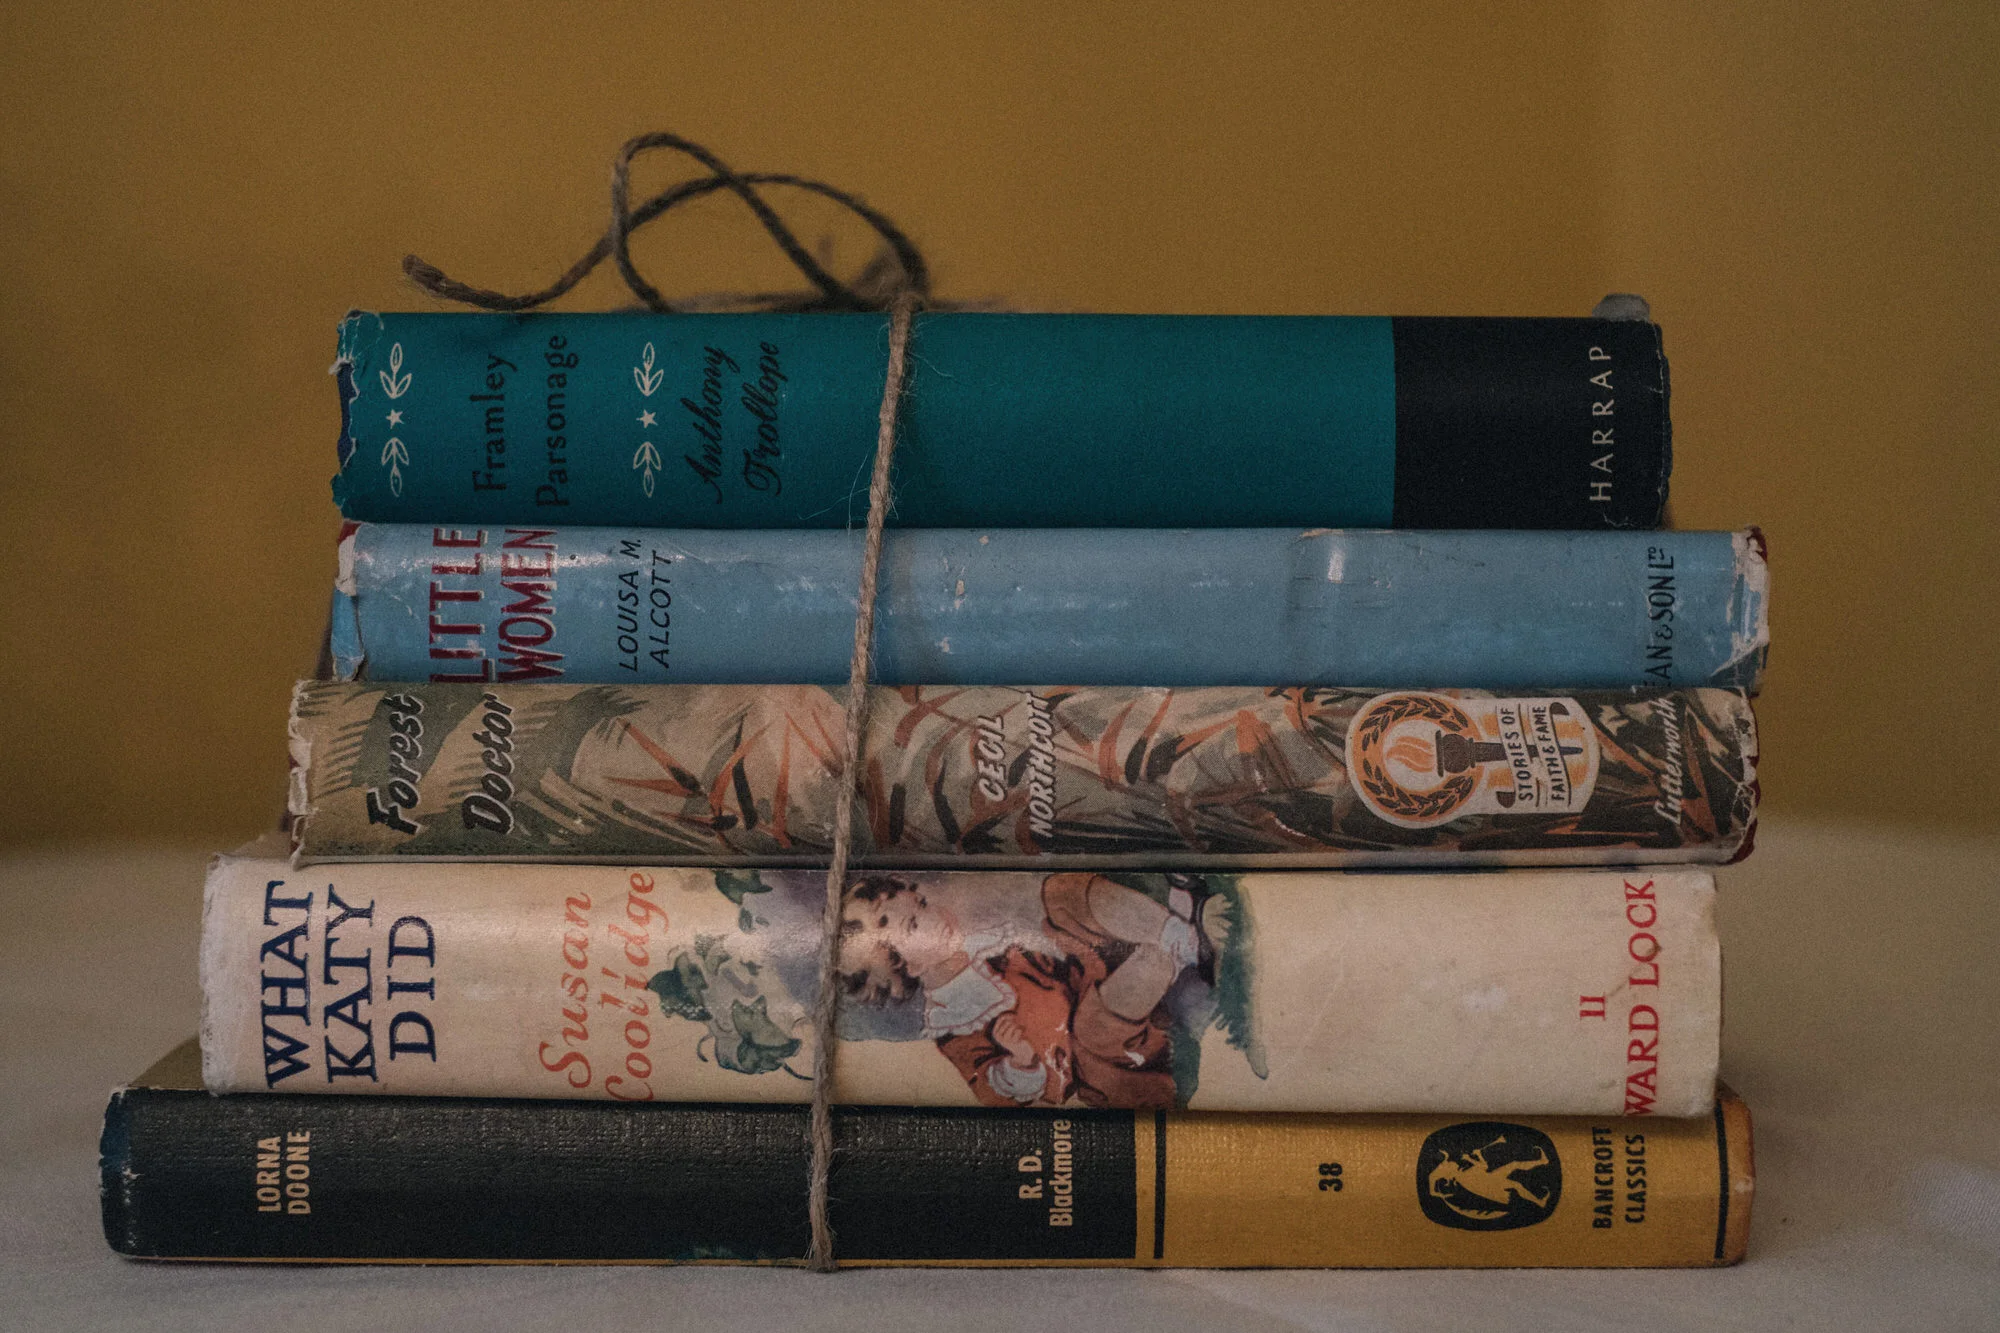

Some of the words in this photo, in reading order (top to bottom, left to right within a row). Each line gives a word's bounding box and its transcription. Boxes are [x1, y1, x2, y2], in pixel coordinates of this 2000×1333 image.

[470, 353, 518, 492] Framley
[536, 335, 579, 506] Parsonage
[680, 346, 741, 504] Anthony
[742, 341, 789, 496] Trollope
[1589, 346, 1615, 501] HARRAP
[620, 538, 642, 559] M.
[1648, 576, 1676, 622] SON
[429, 527, 494, 683] LITTLE
[498, 528, 564, 682] WOMEN
[617, 570, 640, 672] LOUISA
[650, 550, 672, 669] ALCOTT
[1655, 624, 1673, 640] &
[1500, 707, 1516, 725] OF
[1643, 645, 1673, 686] AN
[366, 693, 424, 835] Forest
[462, 692, 515, 835] Doctor
[976, 714, 1007, 802] CECIL
[1025, 691, 1056, 838] NORTHCOTT
[1504, 731, 1534, 801] STORIES
[1532, 706, 1552, 741] FAME
[1542, 745, 1556, 755] &
[1545, 757, 1566, 801] FAITH
[1648, 697, 1683, 825] Lutterworth
[260, 880, 314, 1089] WHAT
[323, 883, 378, 1083] KATY
[387, 915, 437, 1062] DID
[596, 872, 670, 1101] Coolidge
[1623, 878, 1661, 988] LOCK
[538, 891, 593, 1088] Susan
[1623, 1003, 1660, 1117] WARD
[256, 1136, 281, 1212] LORNA
[286, 1131, 311, 1214] DOONE
[1049, 1119, 1073, 1227] Blackmore
[1318, 1161, 1344, 1193] 38
[1592, 1126, 1614, 1228] BANCROFT
[1625, 1134, 1647, 1223] CLASSICS
